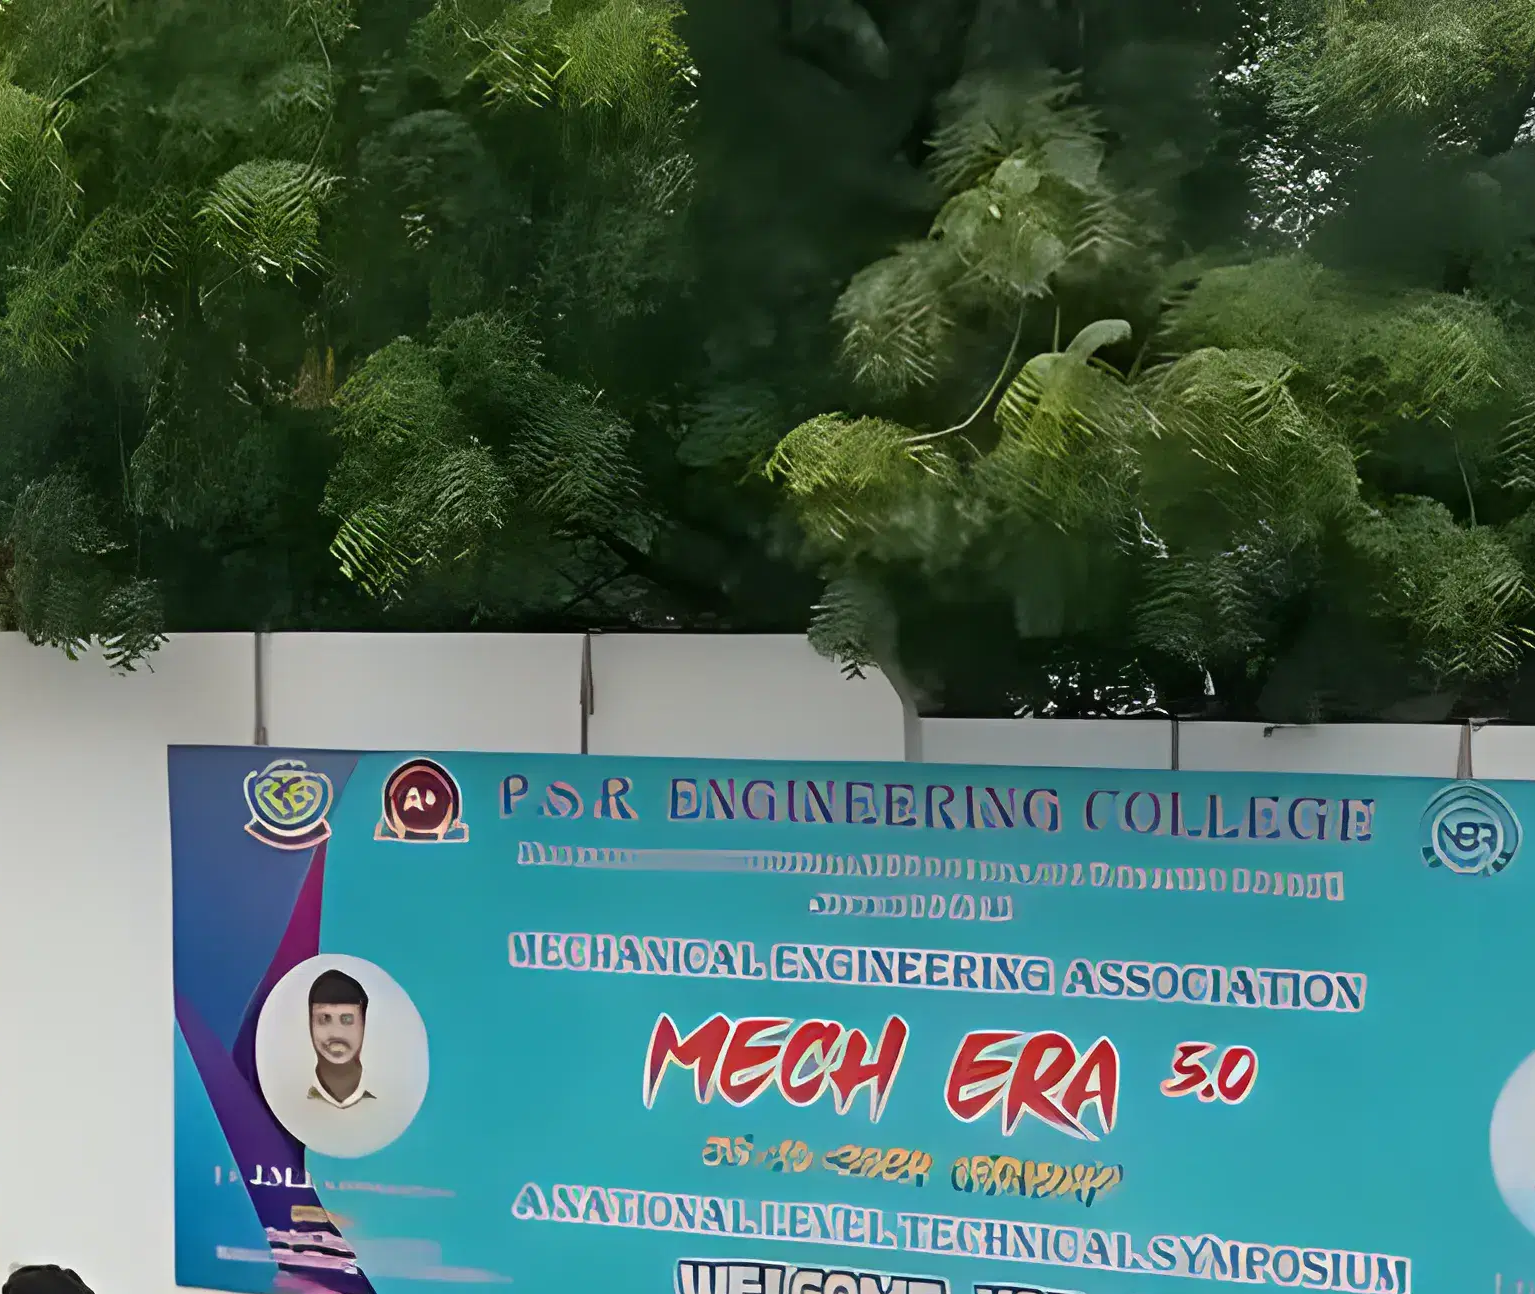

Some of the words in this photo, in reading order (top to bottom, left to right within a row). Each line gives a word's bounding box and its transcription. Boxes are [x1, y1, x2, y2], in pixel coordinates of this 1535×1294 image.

[666, 776, 1062, 832] ENGINEERING
[1084, 789, 1375, 842] COLLEGE
[508, 930, 766, 981] MECHANICAL
[769, 941, 1054, 995] ENGINEERING
[1062, 958, 1367, 1013] ASSOCIATION
[642, 1012, 910, 1124] MECH
[942, 1028, 1120, 1141] ERA
